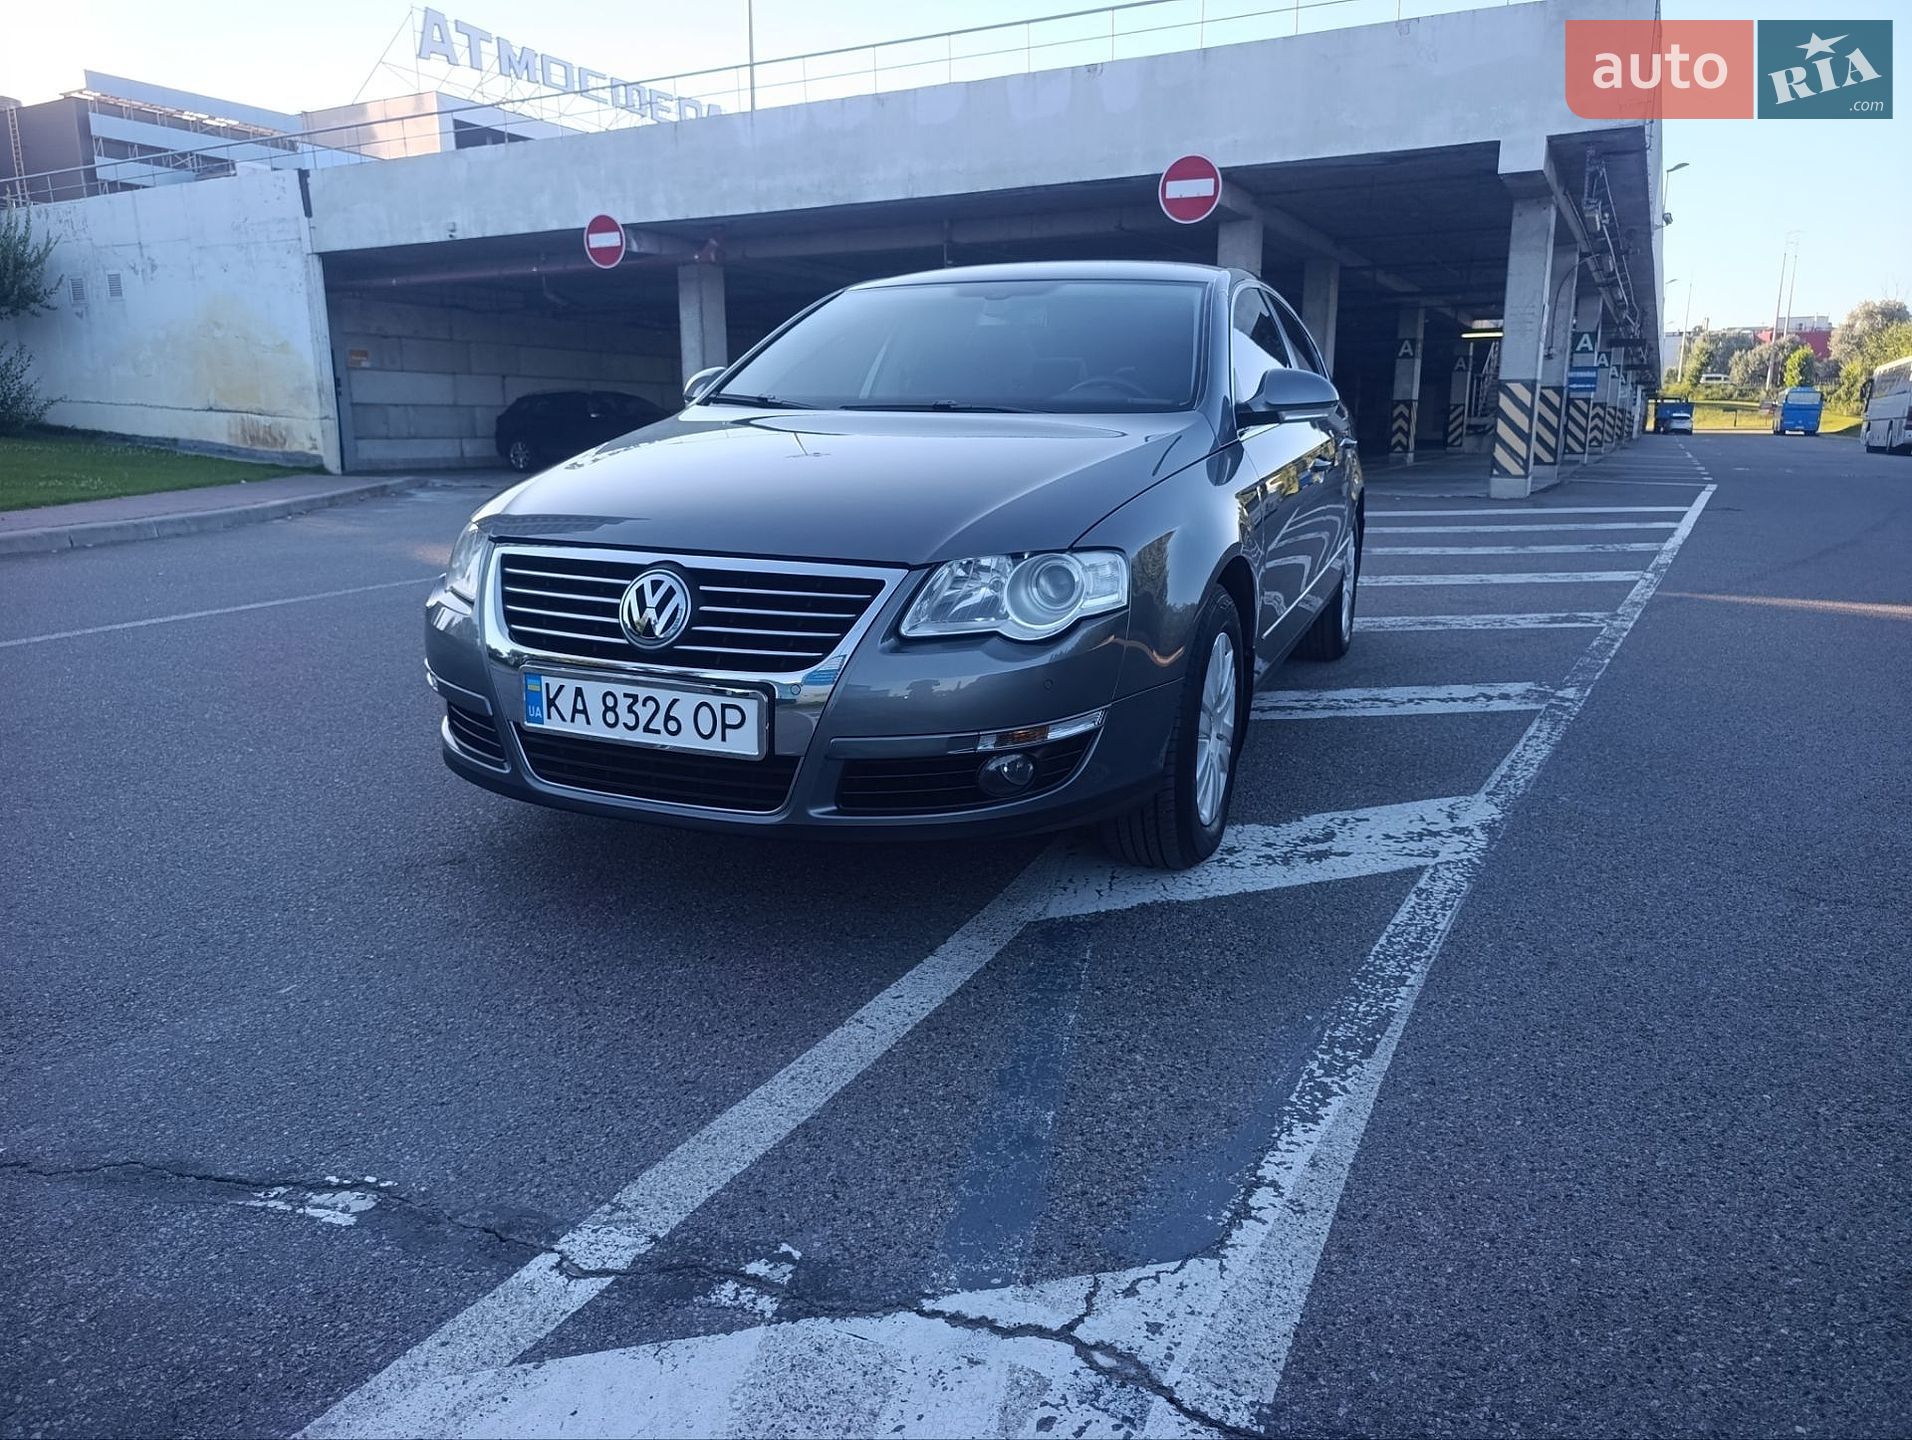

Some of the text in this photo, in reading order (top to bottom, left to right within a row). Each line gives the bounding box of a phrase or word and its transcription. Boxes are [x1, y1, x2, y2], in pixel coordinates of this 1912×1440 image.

[528, 704, 542, 718] UA
[544, 682, 747, 743] KA 8326 OP
